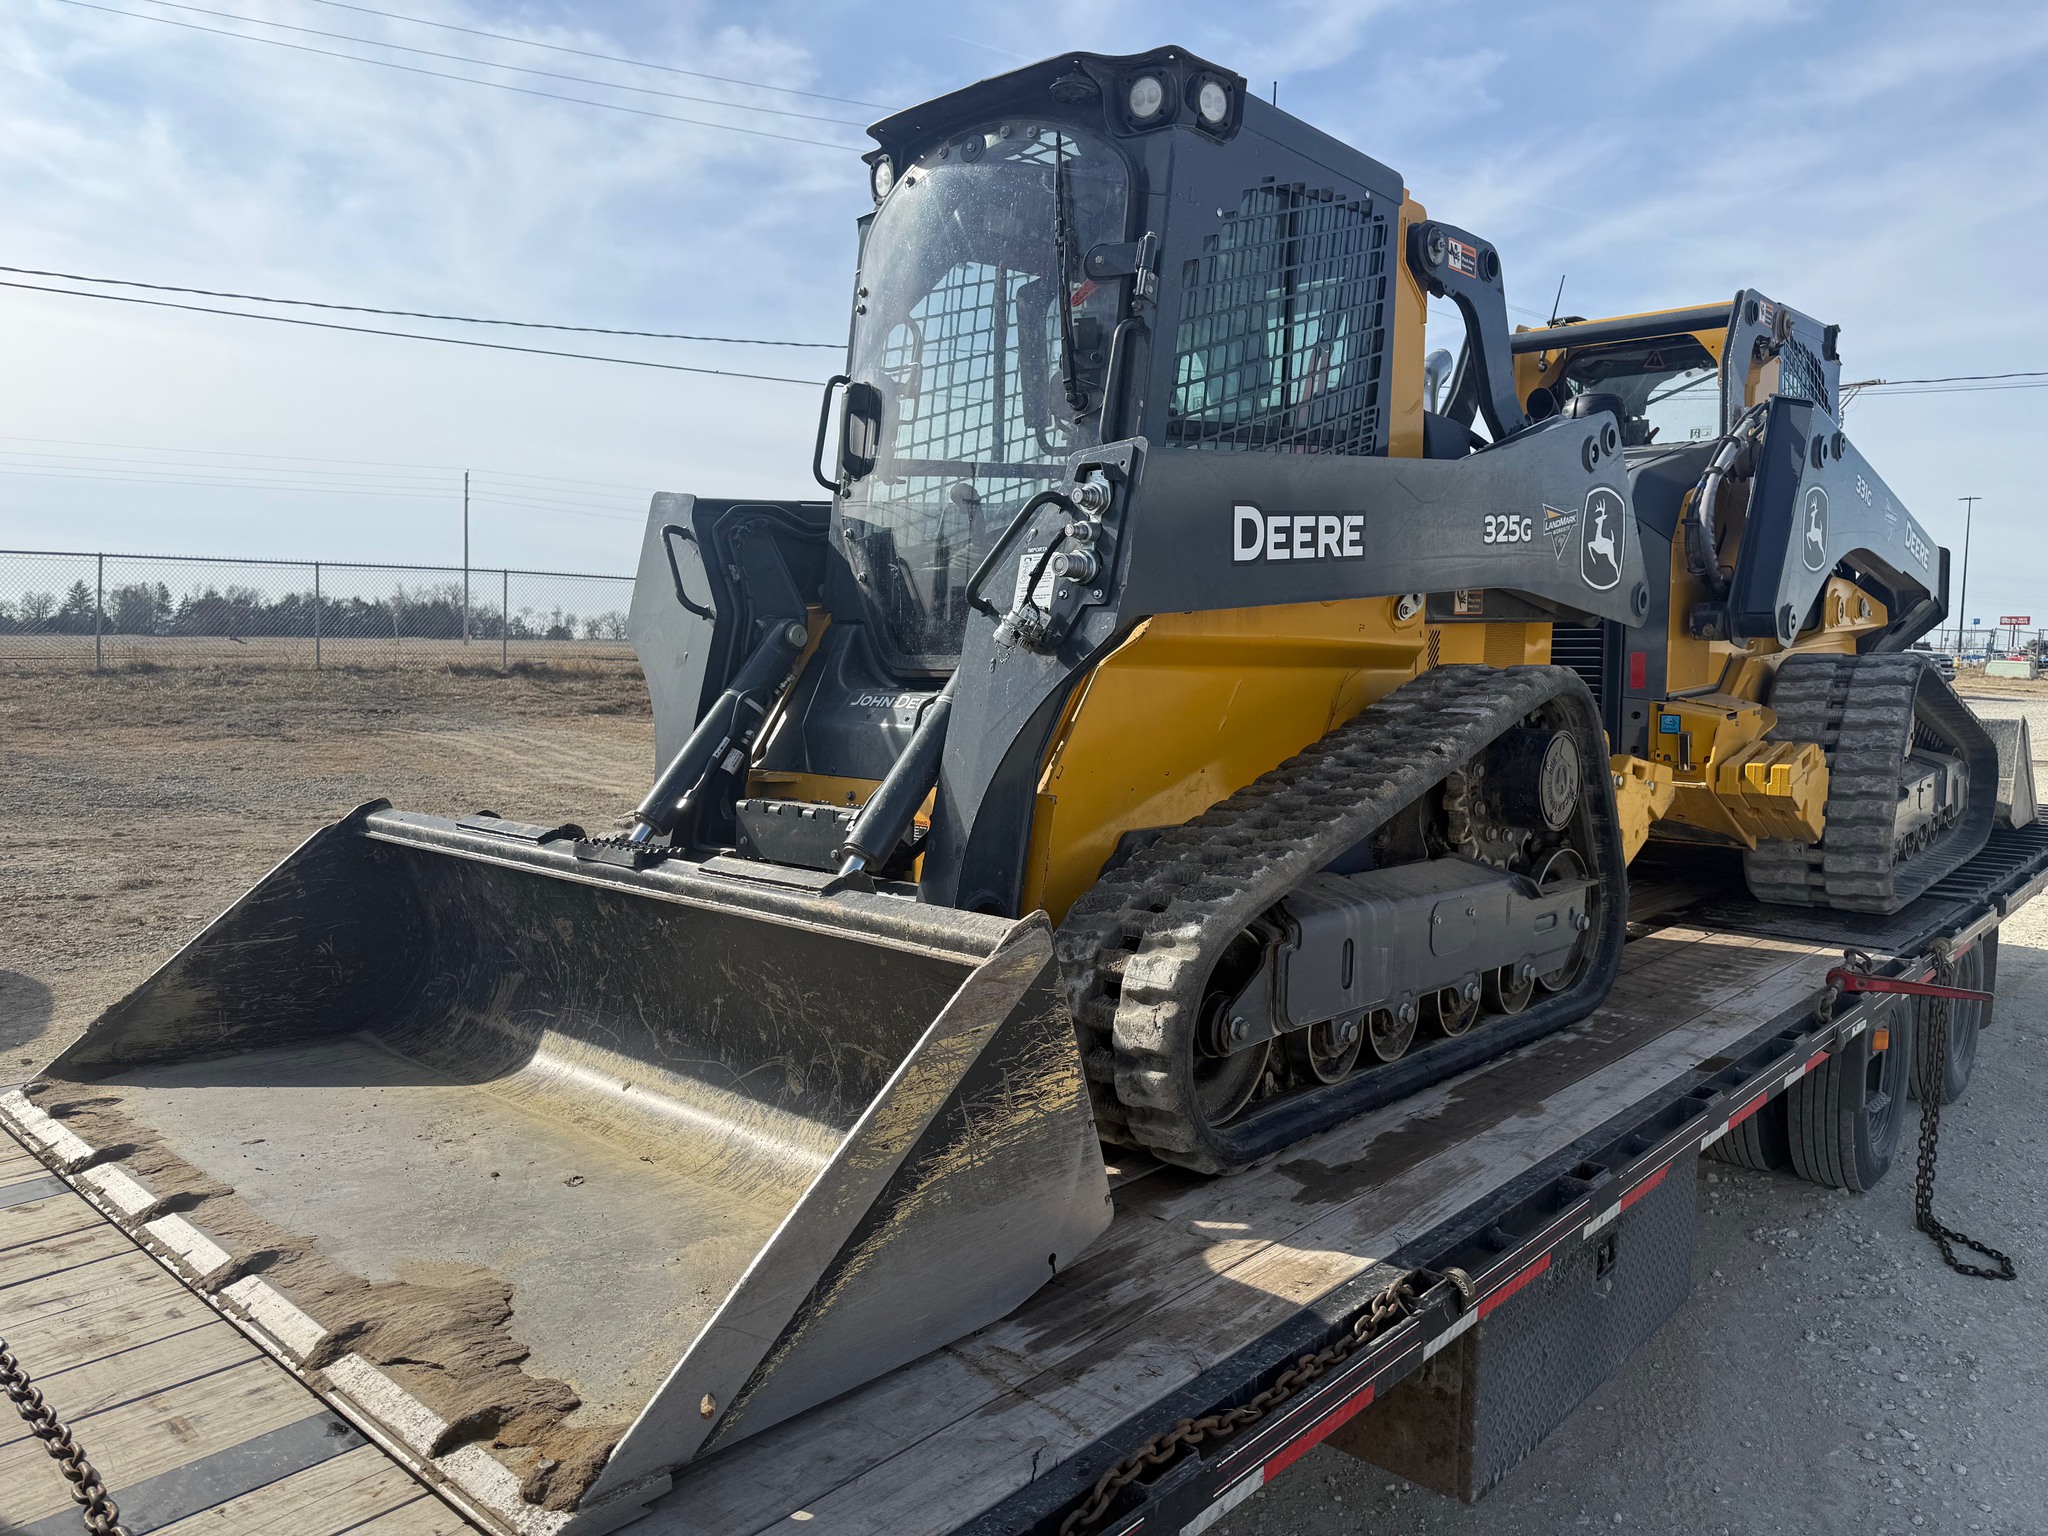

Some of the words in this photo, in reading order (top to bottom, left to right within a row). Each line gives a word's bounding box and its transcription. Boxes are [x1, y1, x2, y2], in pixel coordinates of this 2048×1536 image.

[1234, 505, 1364, 561] DEERE
[1484, 515, 1532, 543] 325G
[1545, 515, 1577, 531] LANDMARK
[1904, 520, 1930, 570] DEERE
[850, 693, 895, 708] JOHN
[894, 696, 927, 709] DEE
